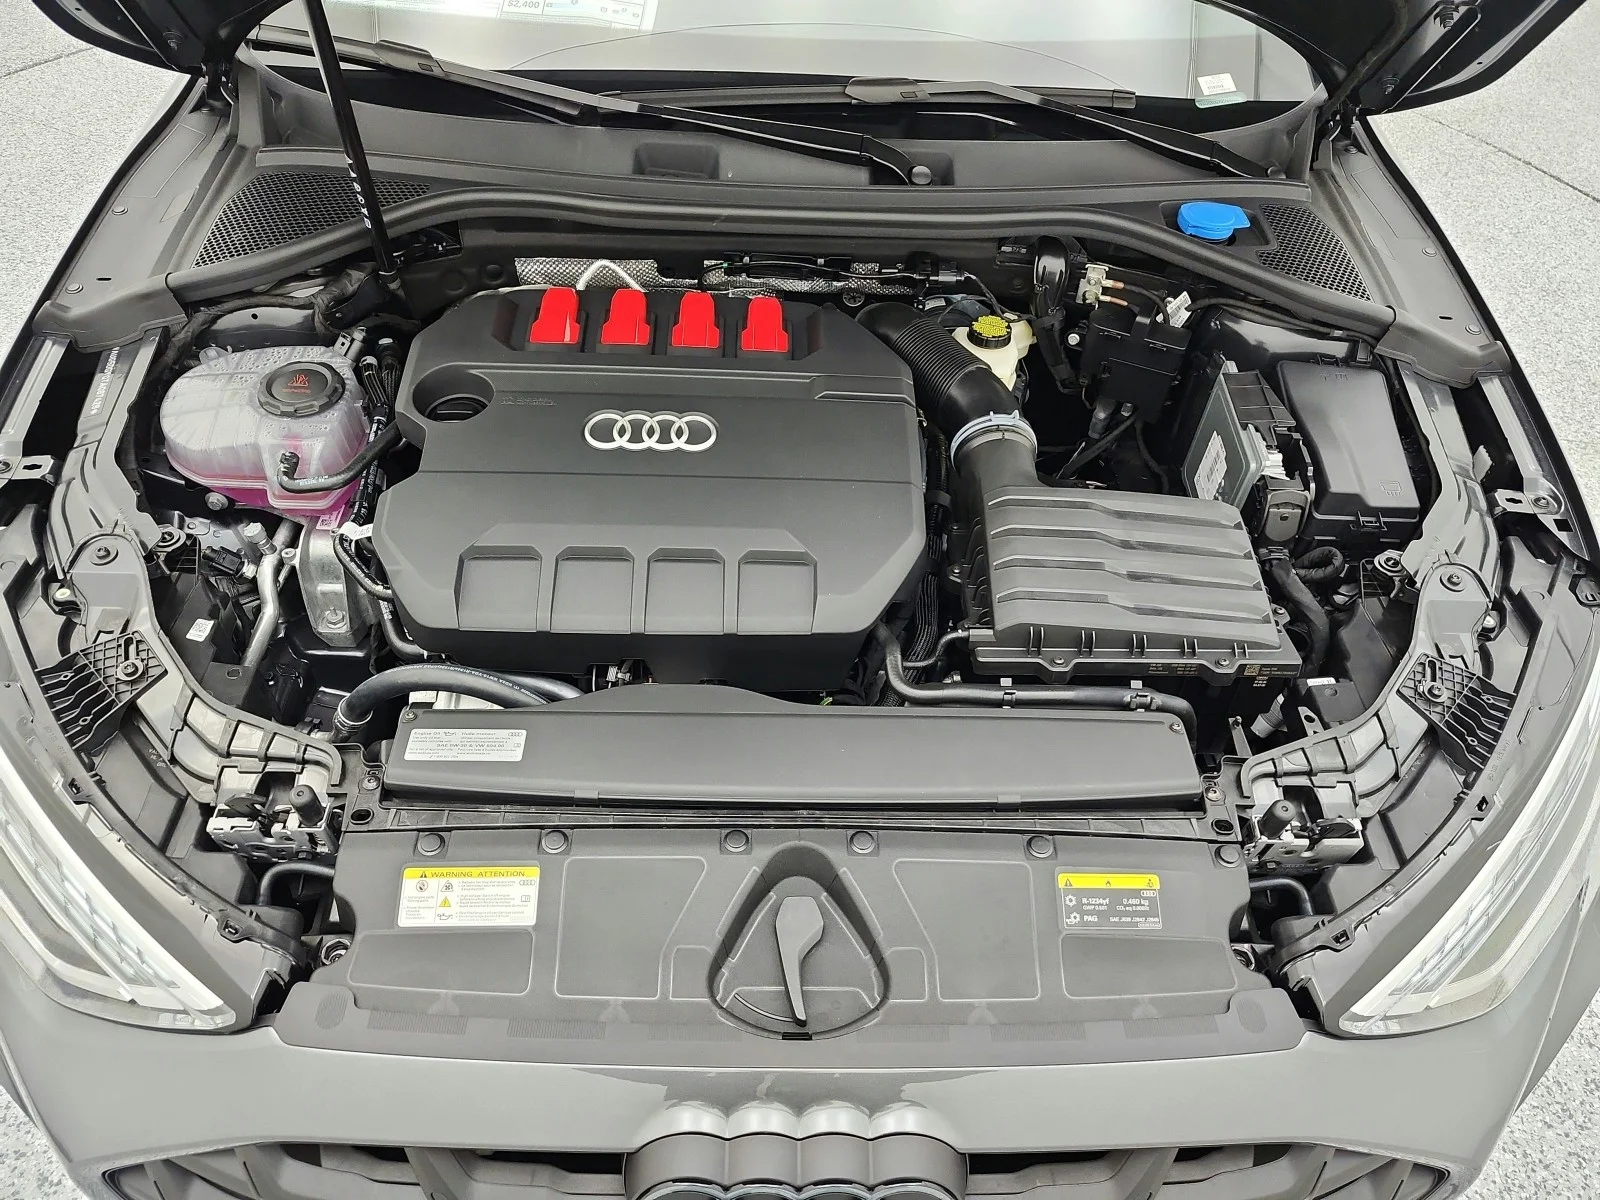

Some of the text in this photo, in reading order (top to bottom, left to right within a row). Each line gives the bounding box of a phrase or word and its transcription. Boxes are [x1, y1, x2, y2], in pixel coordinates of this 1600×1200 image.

[507, 0, 540, 8] $2,400
[1081, 897, 1110, 905] R-1234yf
[1141, 898, 1149, 906] kg
